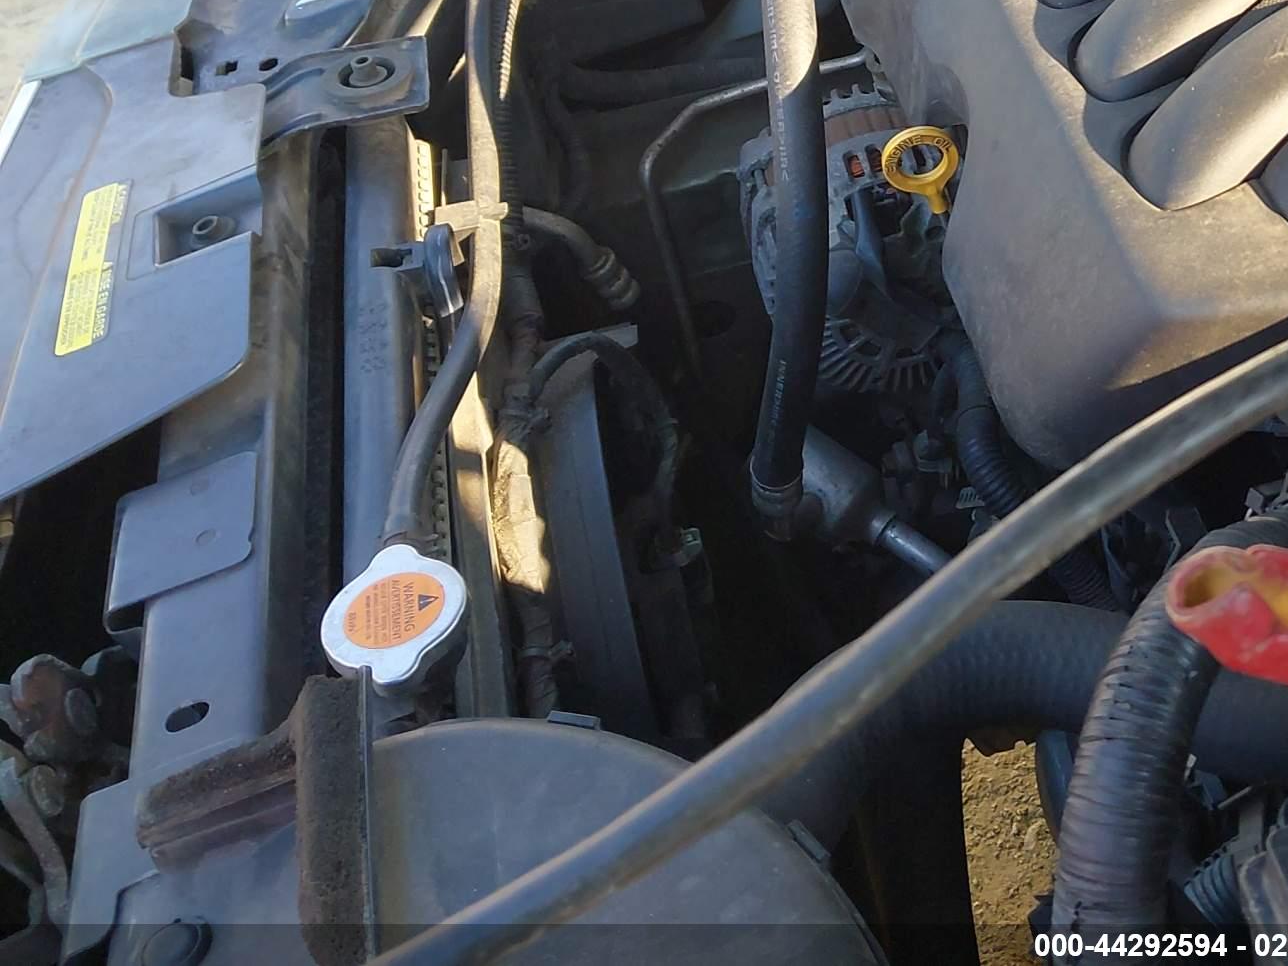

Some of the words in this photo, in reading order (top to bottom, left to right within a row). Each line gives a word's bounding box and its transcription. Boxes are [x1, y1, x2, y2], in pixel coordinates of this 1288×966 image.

[885, 134, 922, 173] ENGINE
[933, 136, 953, 154] OIL
[93, 305, 108, 339] GARDE
[391, 579, 402, 641] AVERTISSEMENT
[403, 581, 416, 633] WARNING
